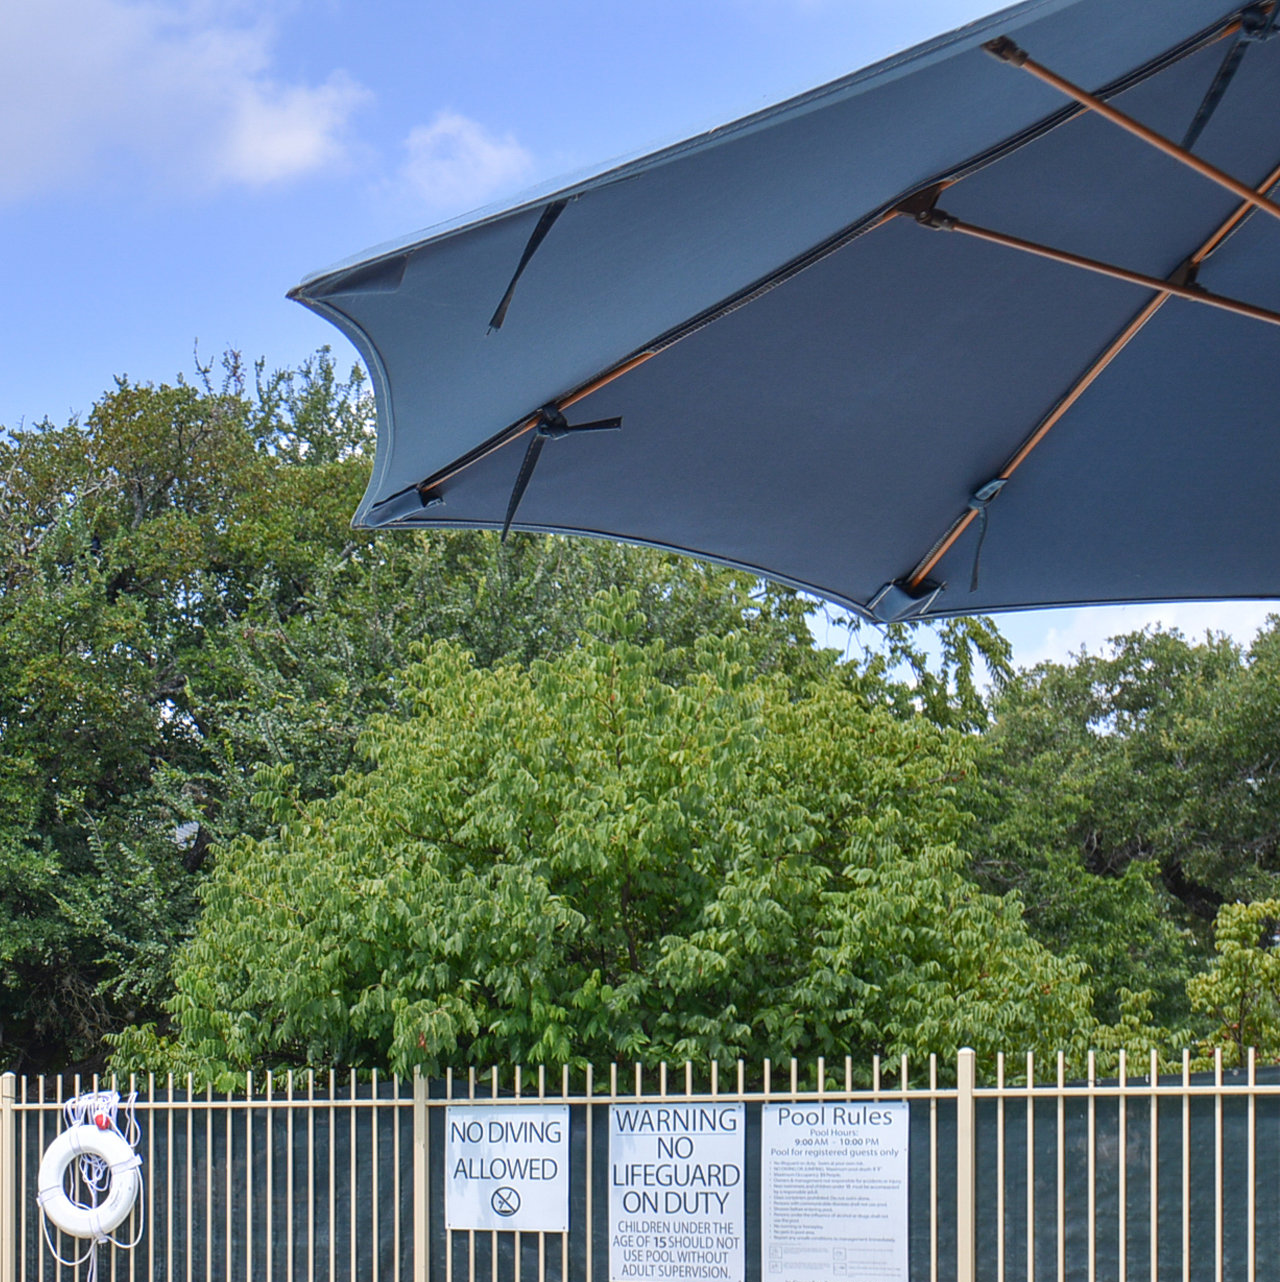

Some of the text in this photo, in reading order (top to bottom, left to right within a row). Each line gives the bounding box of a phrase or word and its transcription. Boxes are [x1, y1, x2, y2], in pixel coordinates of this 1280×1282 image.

[616, 1108, 737, 1132] WARNING
[778, 1106, 893, 1126] Pool Rules
[451, 1122, 561, 1143] NO DIVING
[831, 1129, 859, 1137] Hours:
[657, 1136, 694, 1159] NO
[795, 1138, 813, 1146] 9:00
[814, 1138, 828, 1146] AM
[840, 1138, 863, 1146] 10:00
[865, 1138, 879, 1146] PM
[771, 1148, 899, 1158] Pool for registered guests only
[453, 1158, 558, 1180] ALLOWED
[613, 1164, 740, 1187] LIFEGUARD
[623, 1191, 729, 1214] ON DUTY
[618, 1220, 734, 1235] CHILDREN UNDER THE
[613, 1235, 740, 1249] AGE OF 15 SHOULD NOT
[623, 1250, 728, 1264] USE POOL WITHOUT
[621, 1264, 732, 1279] ADULT SUPERVISION.
